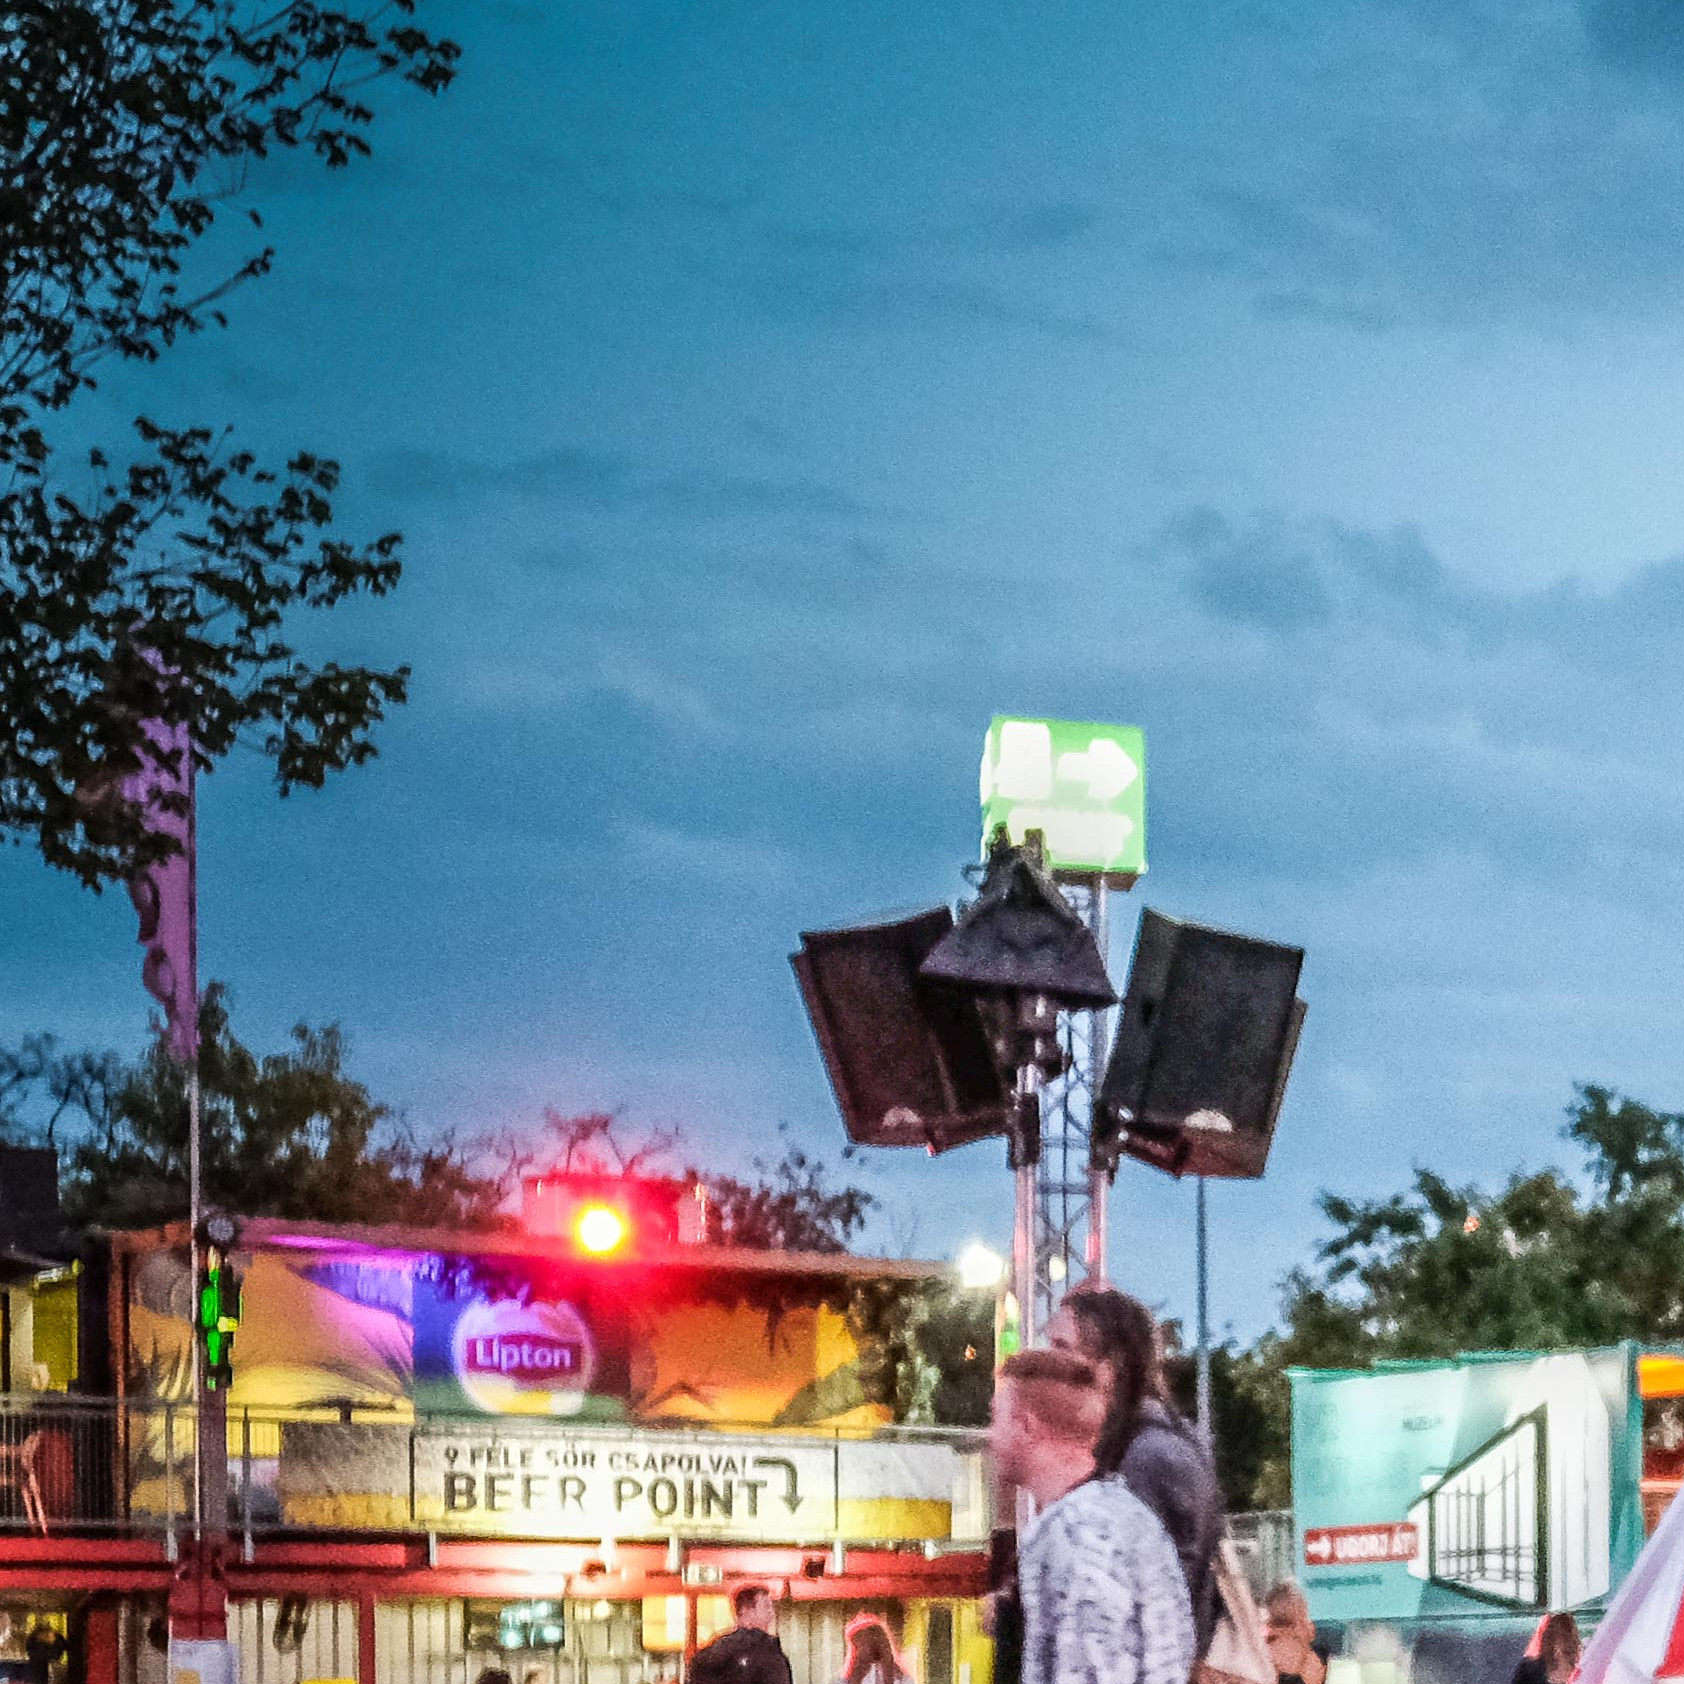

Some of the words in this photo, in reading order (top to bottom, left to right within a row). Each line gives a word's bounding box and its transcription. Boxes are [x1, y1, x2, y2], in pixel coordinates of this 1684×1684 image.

[475, 1340, 571, 1371] Lipton
[444, 1471, 587, 1512] BEER
[614, 1476, 768, 1520] POINT
